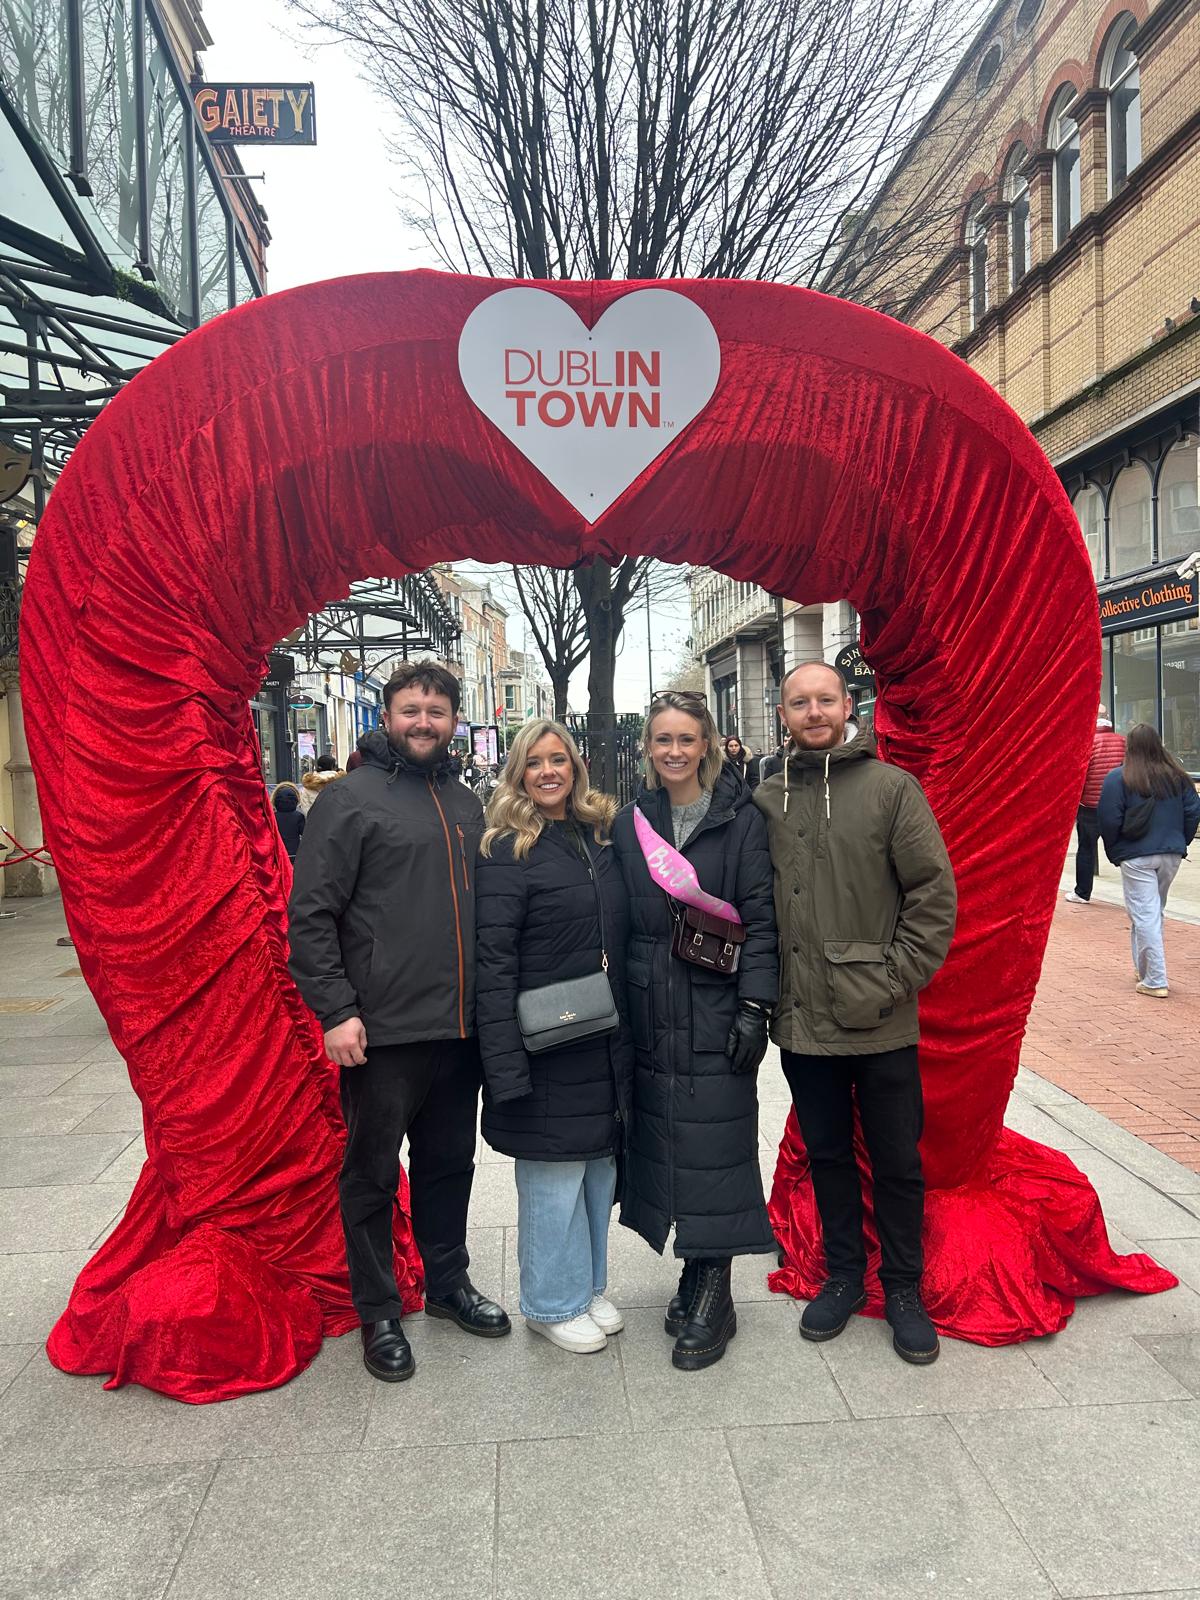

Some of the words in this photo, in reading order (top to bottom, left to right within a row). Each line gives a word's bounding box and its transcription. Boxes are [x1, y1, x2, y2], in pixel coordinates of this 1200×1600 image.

[194, 88, 309, 133] GAIETY
[230, 126, 276, 137] THEATRE
[504, 349, 661, 387] DUBLIN
[505, 390, 661, 428] TOWN
[1141, 583, 1193, 604] Clothing
